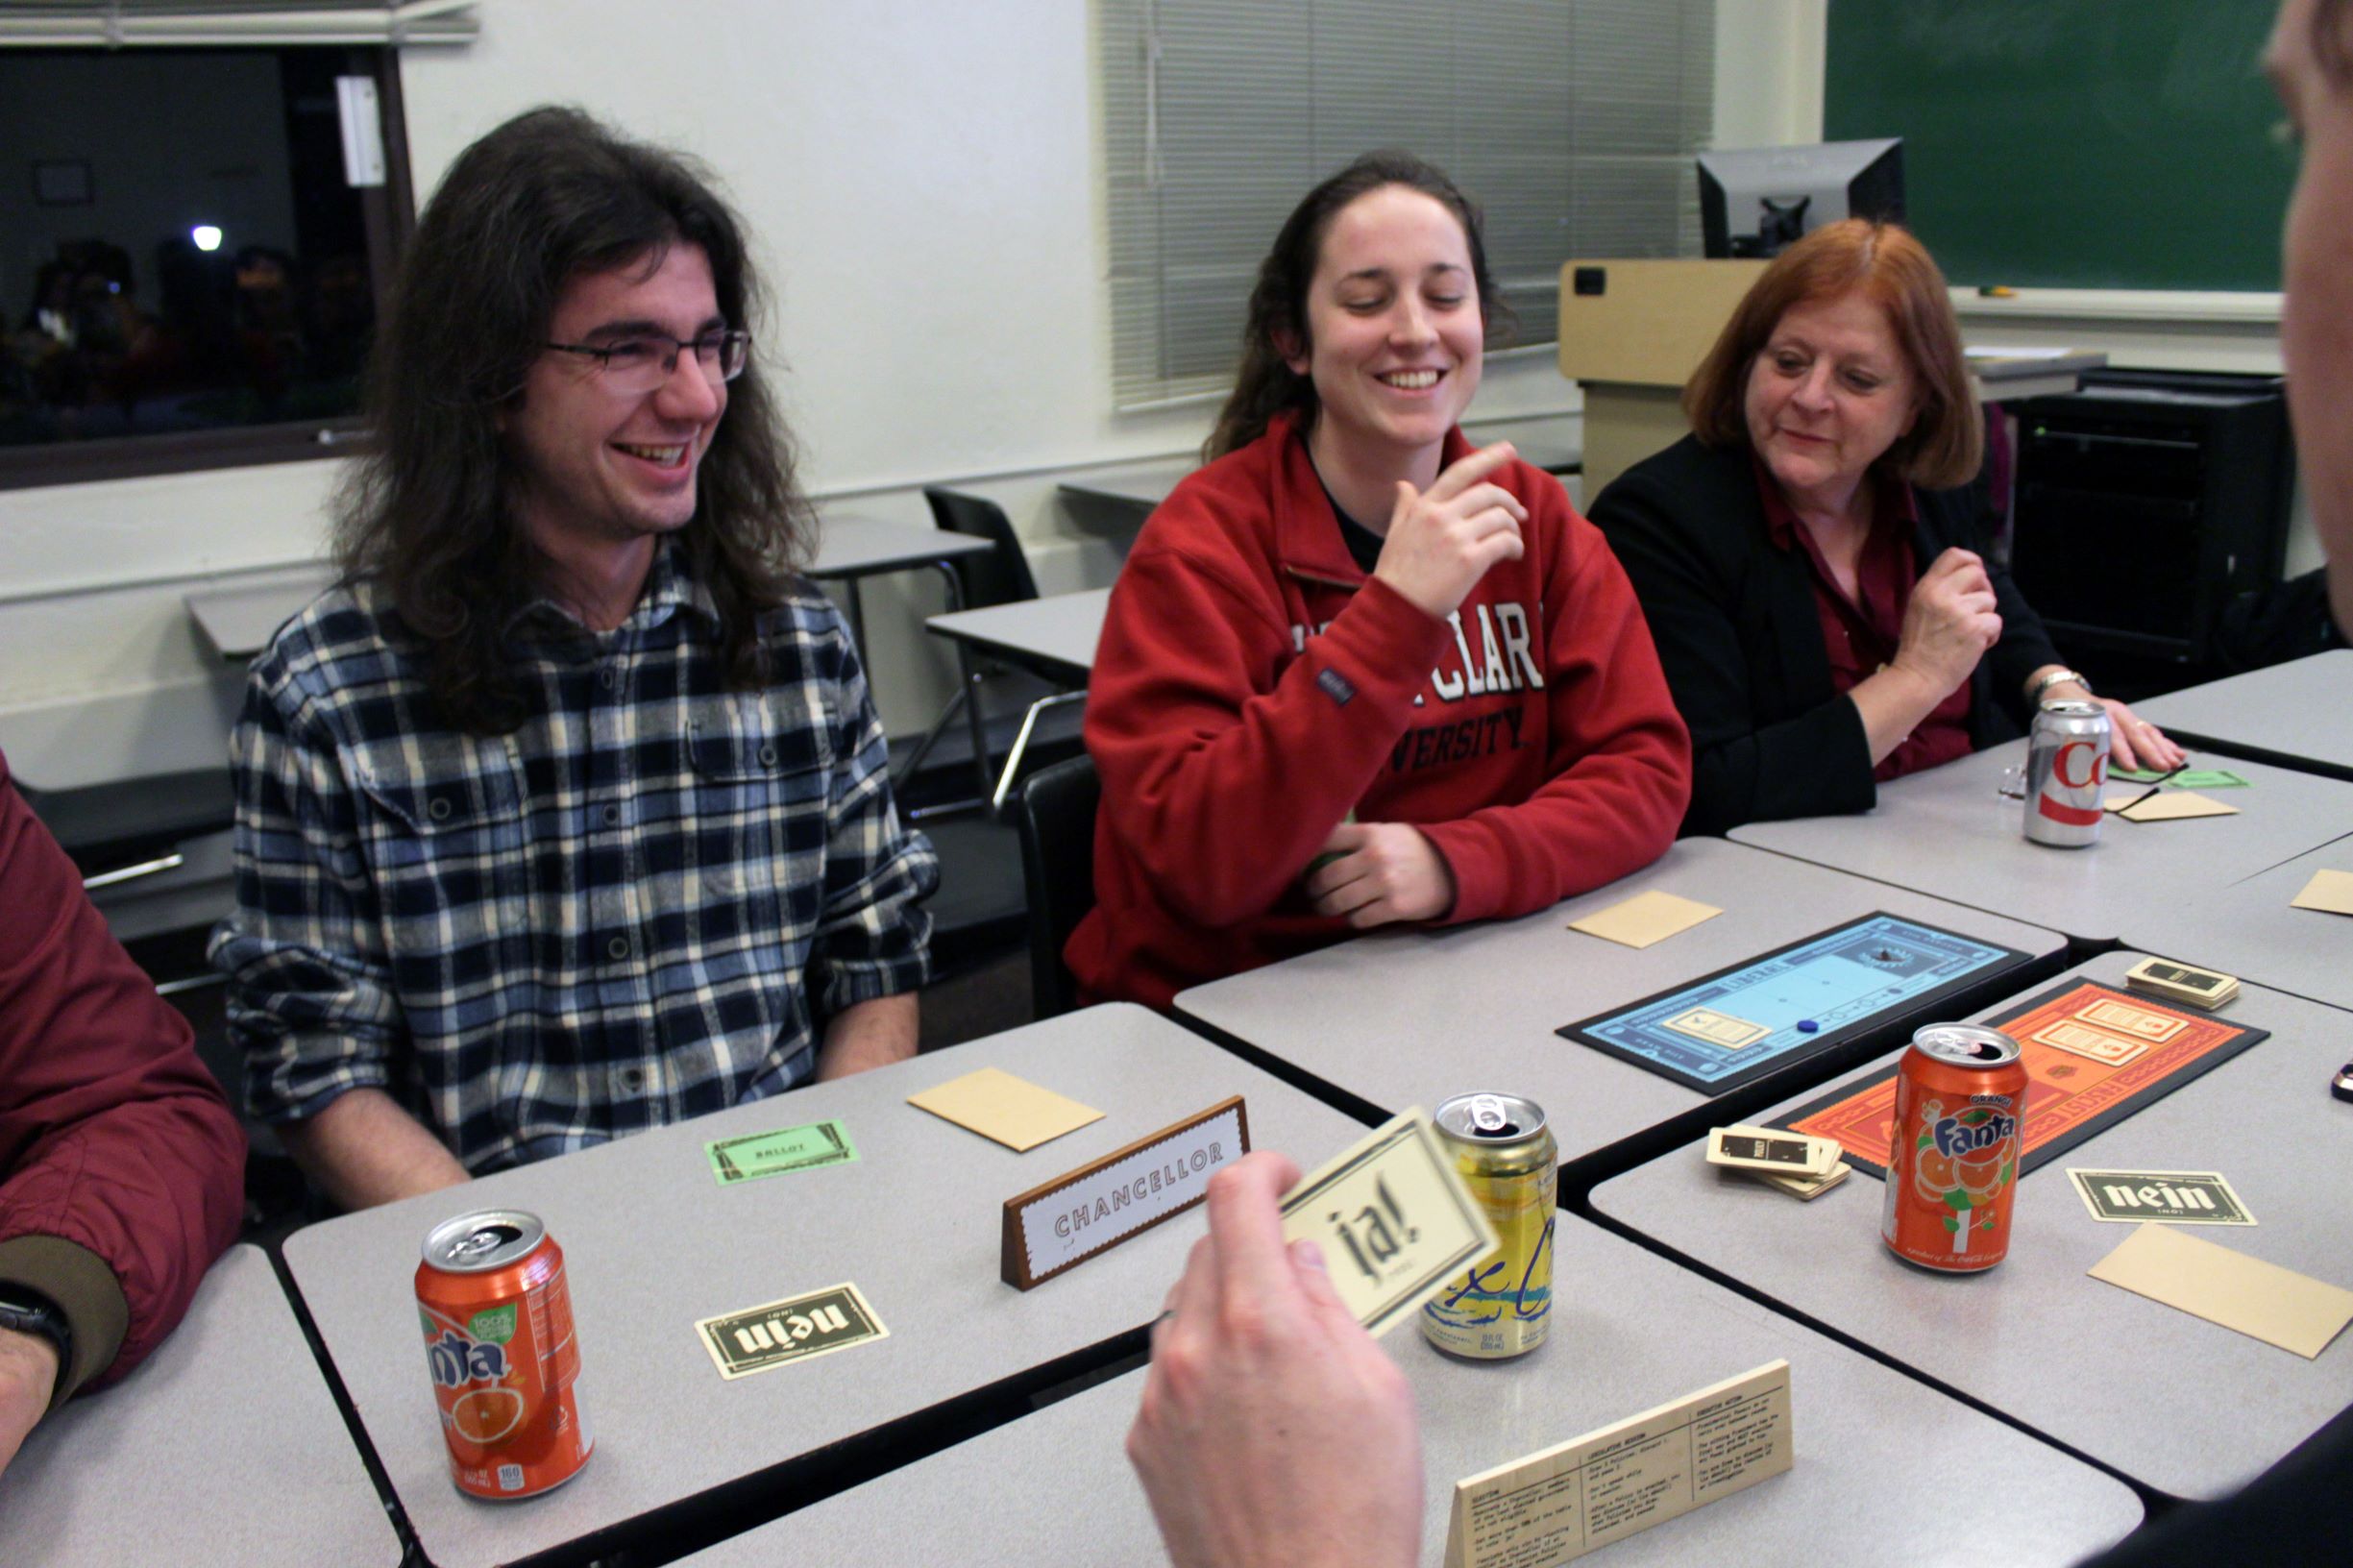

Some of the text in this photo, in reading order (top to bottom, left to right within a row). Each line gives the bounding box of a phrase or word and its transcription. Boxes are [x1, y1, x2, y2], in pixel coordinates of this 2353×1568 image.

[1430, 600, 1544, 701] CLAR
[1392, 704, 1526, 771] VERSITY
[755, 1143, 805, 1159] BALLOT
[1934, 1115, 2015, 1158] Fanta
[1055, 1141, 1223, 1237] CHANCELLOR
[2103, 1182, 2216, 1211] nein
[734, 1304, 849, 1354] nein
[430, 1331, 505, 1387] nta
